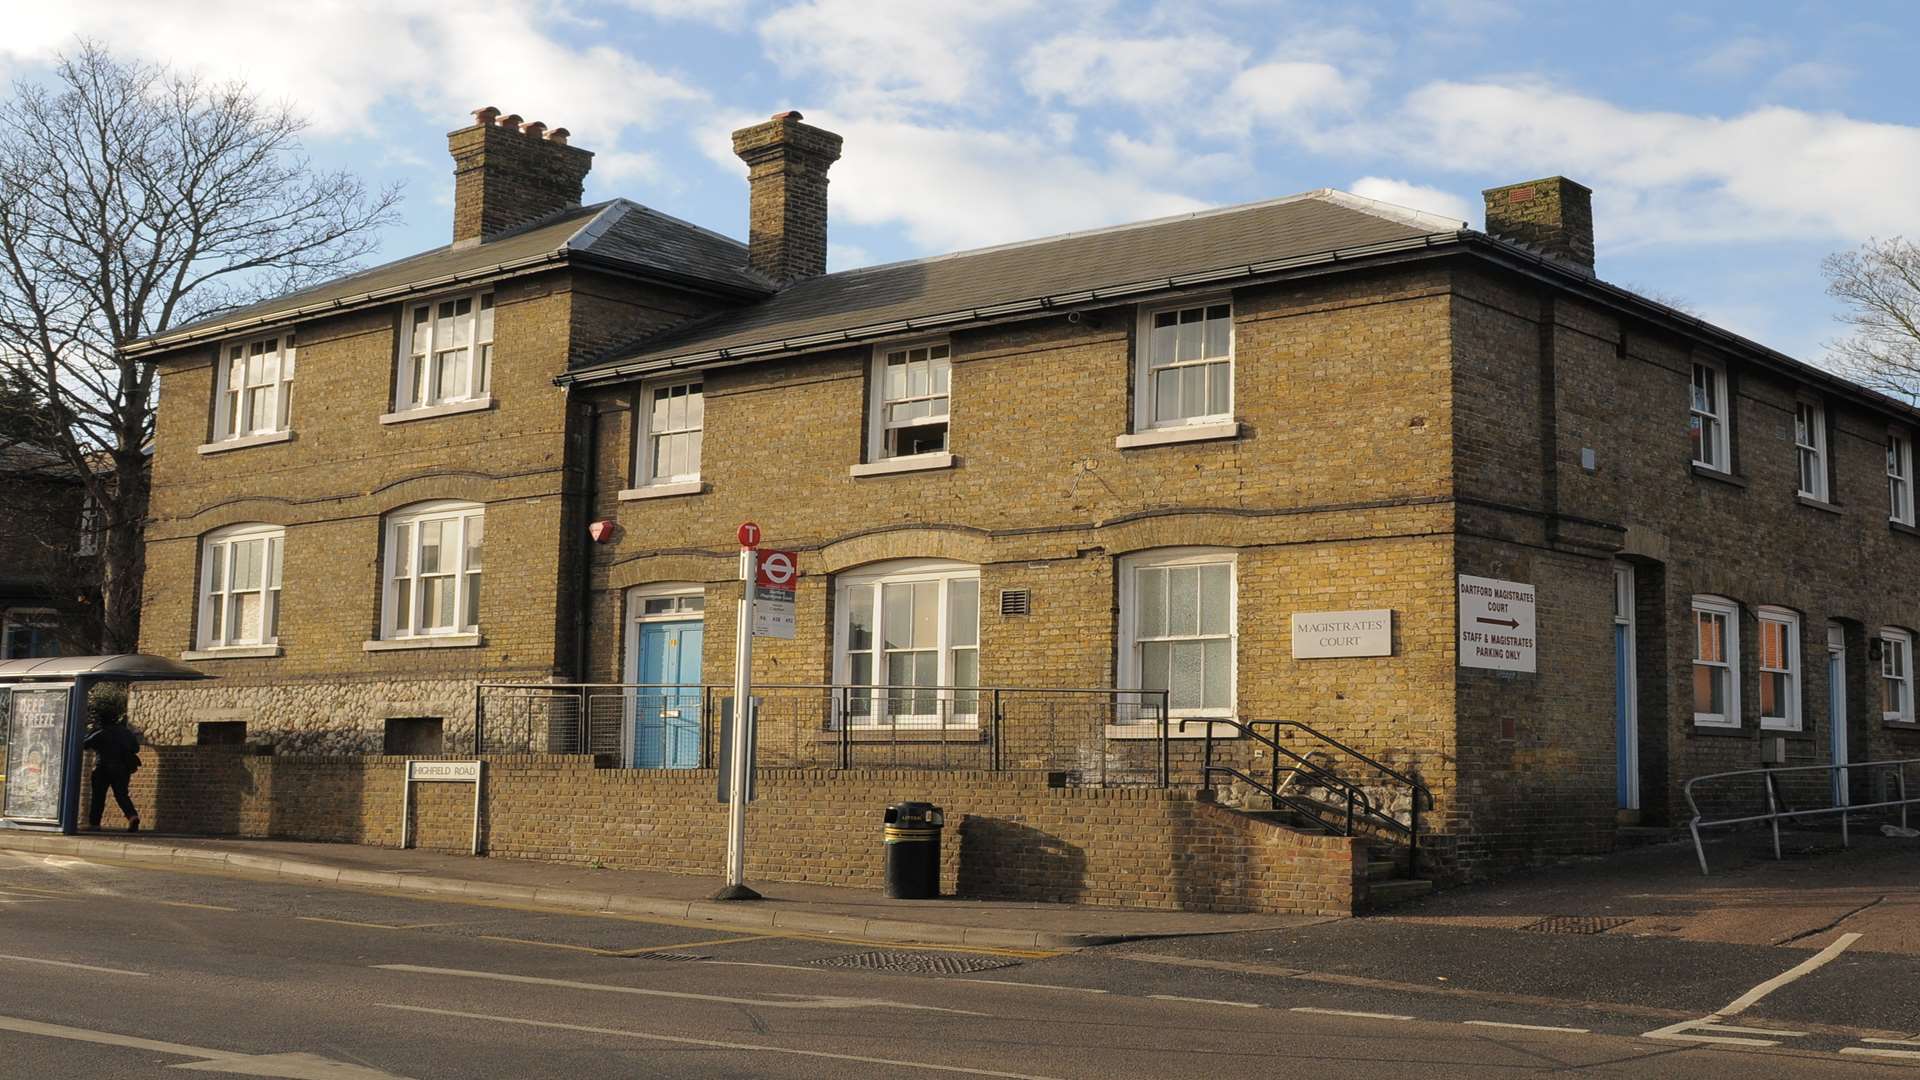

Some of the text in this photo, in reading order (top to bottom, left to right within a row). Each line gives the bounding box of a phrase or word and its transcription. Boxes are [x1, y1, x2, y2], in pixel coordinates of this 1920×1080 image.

[745, 526, 756, 543] T
[1461, 584, 1533, 603] DARTFORD MAGISTRATES
[1488, 602, 1508, 613] COURT
[1298, 620, 1386, 633] MAGISTRATES'
[1319, 636, 1361, 647] COURT
[1463, 631, 1533, 648] STAFF & MAGISTRATES
[1476, 646, 1521, 660] PARKING ONLY
[23, 712, 56, 728] FREEZE
[414, 766, 476, 776] HIGHFIELD ROAD
